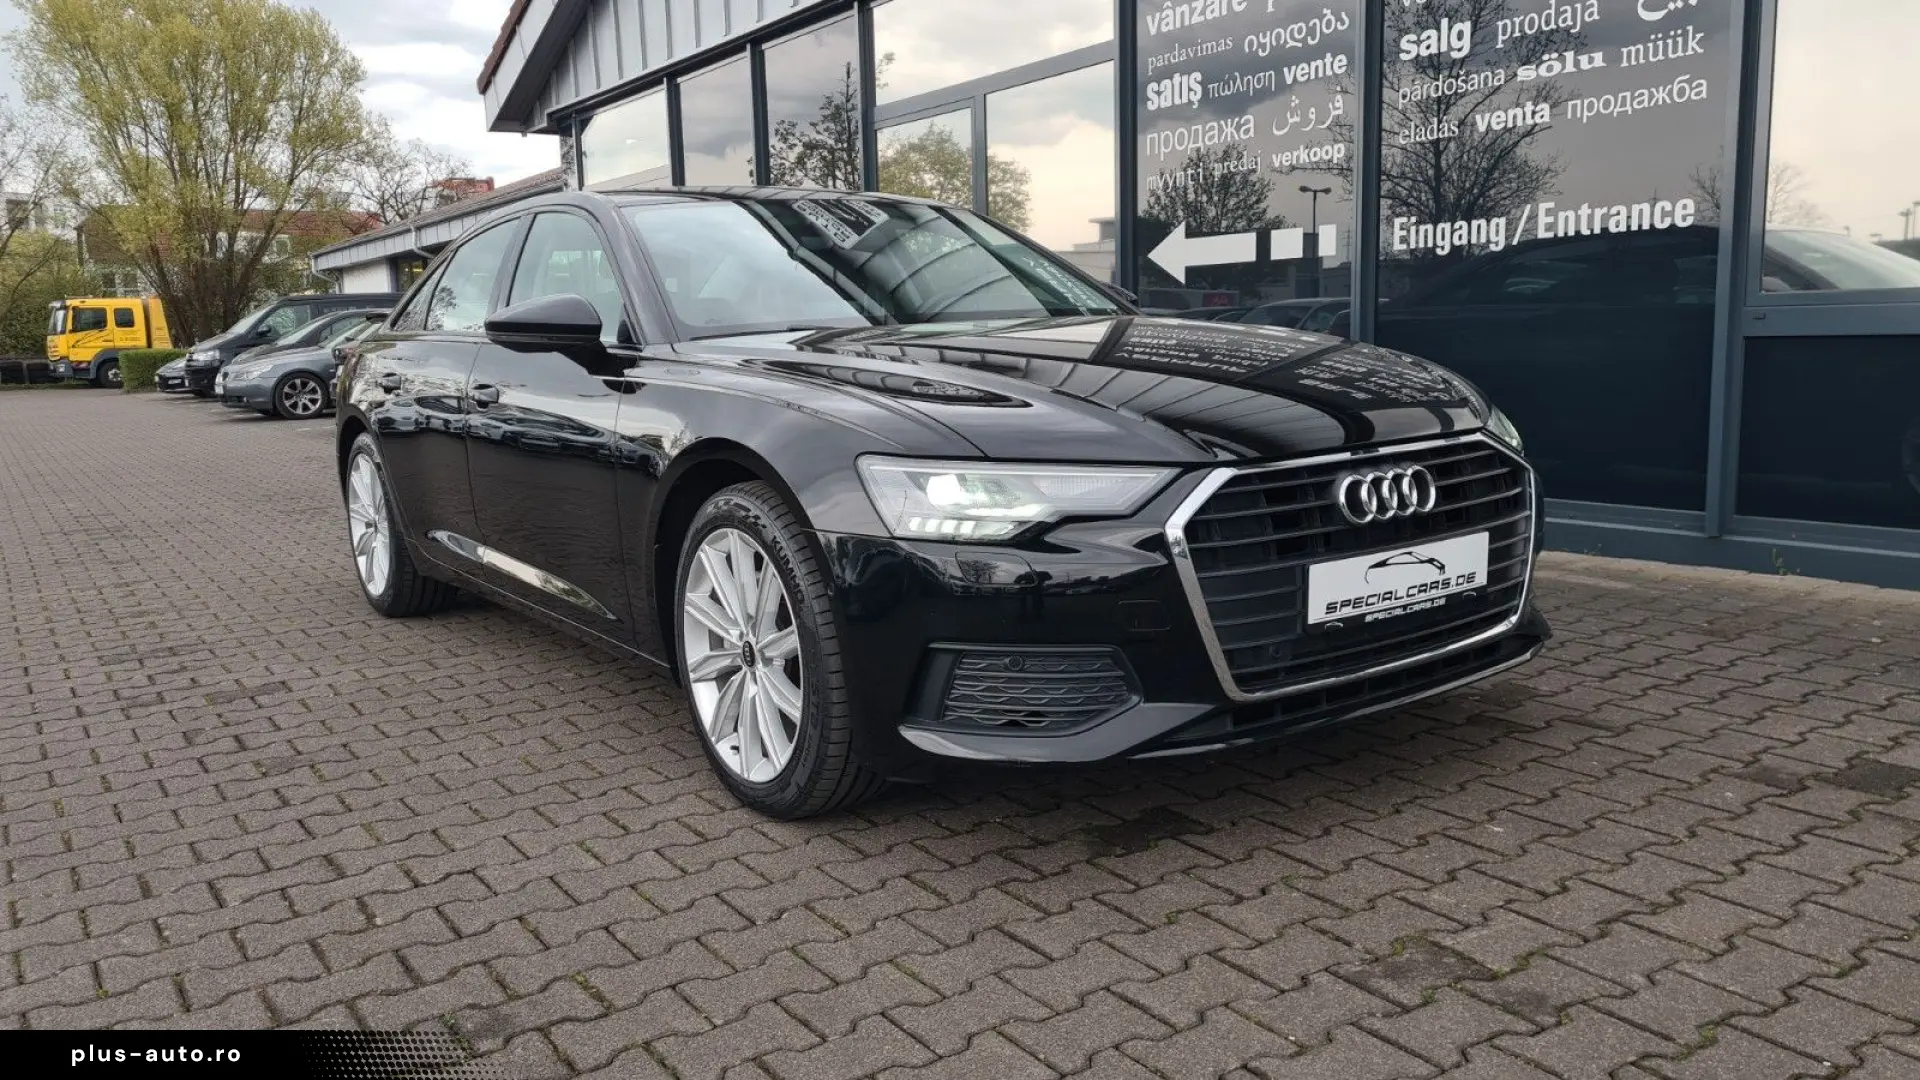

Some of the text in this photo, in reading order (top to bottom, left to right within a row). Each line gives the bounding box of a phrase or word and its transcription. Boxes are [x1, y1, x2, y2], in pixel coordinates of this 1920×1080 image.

[1244, 8, 1350, 57] იყიდება
[1399, 18, 1471, 60] salg
[1497, 0, 1600, 48] prodaja
[1148, 37, 1233, 75] pardavimas
[1283, 53, 1348, 85] vente
[1399, 25, 1705, 109] pārdošana sölu müük
[1146, 71, 1202, 111] satış
[1208, 70, 1276, 99] πώληση
[1567, 74, 1708, 123] продажба
[1273, 86, 1344, 136] فروش
[1399, 101, 1551, 145] eladás venta
[1146, 114, 1255, 161] продажа
[1214, 150, 1261, 181] predaj
[1272, 143, 1345, 168] verkoop
[1393, 215, 1506, 256] Eingang
[1536, 198, 1695, 240] Entrance
[1325, 571, 1477, 615] SPECIALCARS.DE
[1364, 597, 1446, 623] SPECIALCARS.DE
